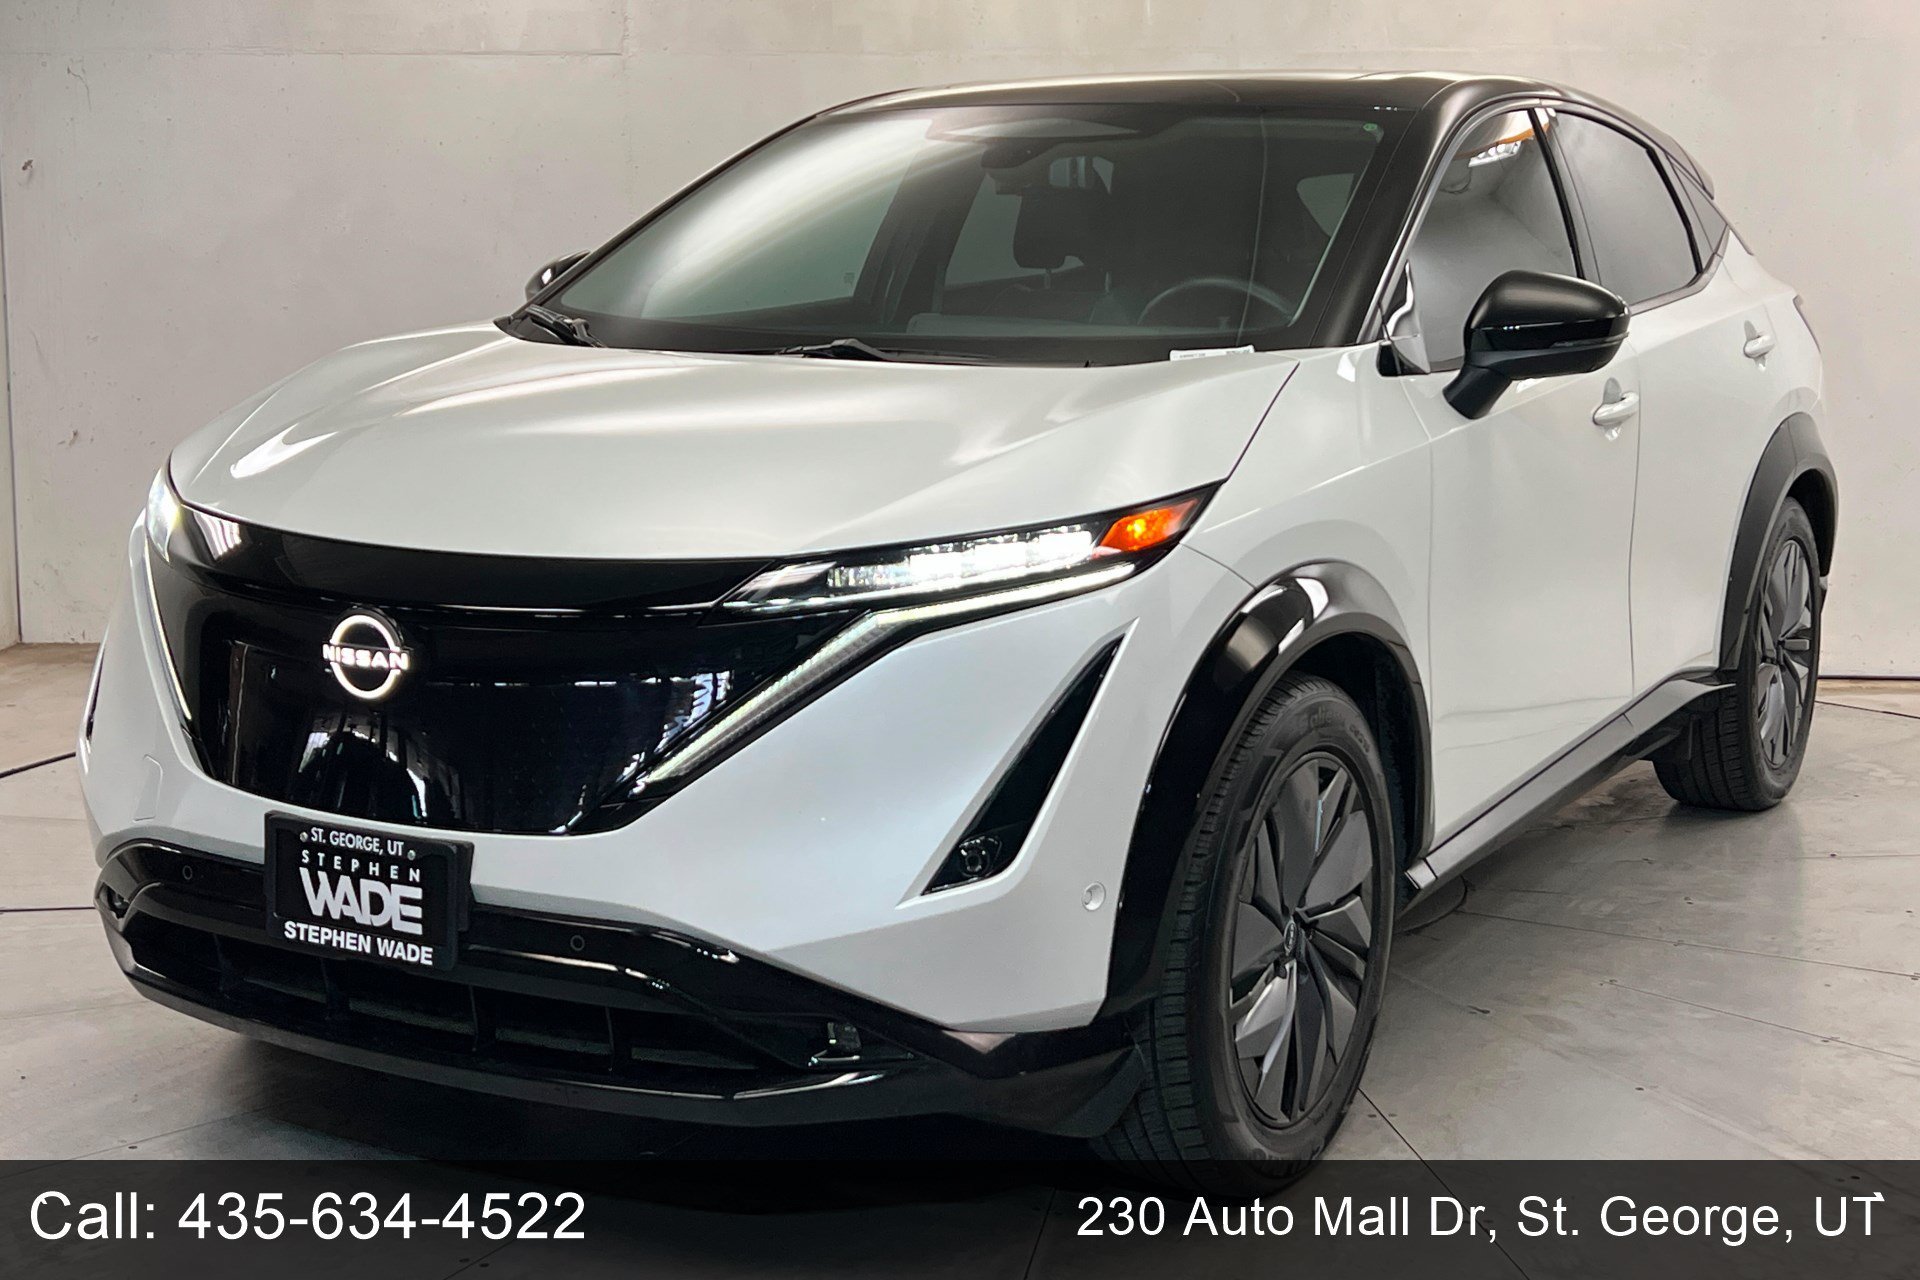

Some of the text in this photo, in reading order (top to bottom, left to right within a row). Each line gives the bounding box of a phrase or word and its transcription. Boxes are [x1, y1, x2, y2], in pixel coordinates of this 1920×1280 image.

[322, 643, 410, 671] NISSAN
[310, 826, 405, 857] ST. GEORGE, UT
[301, 849, 421, 883] STEPHEN
[299, 866, 423, 936] WADE
[284, 920, 434, 966] STEPHEN WADE
